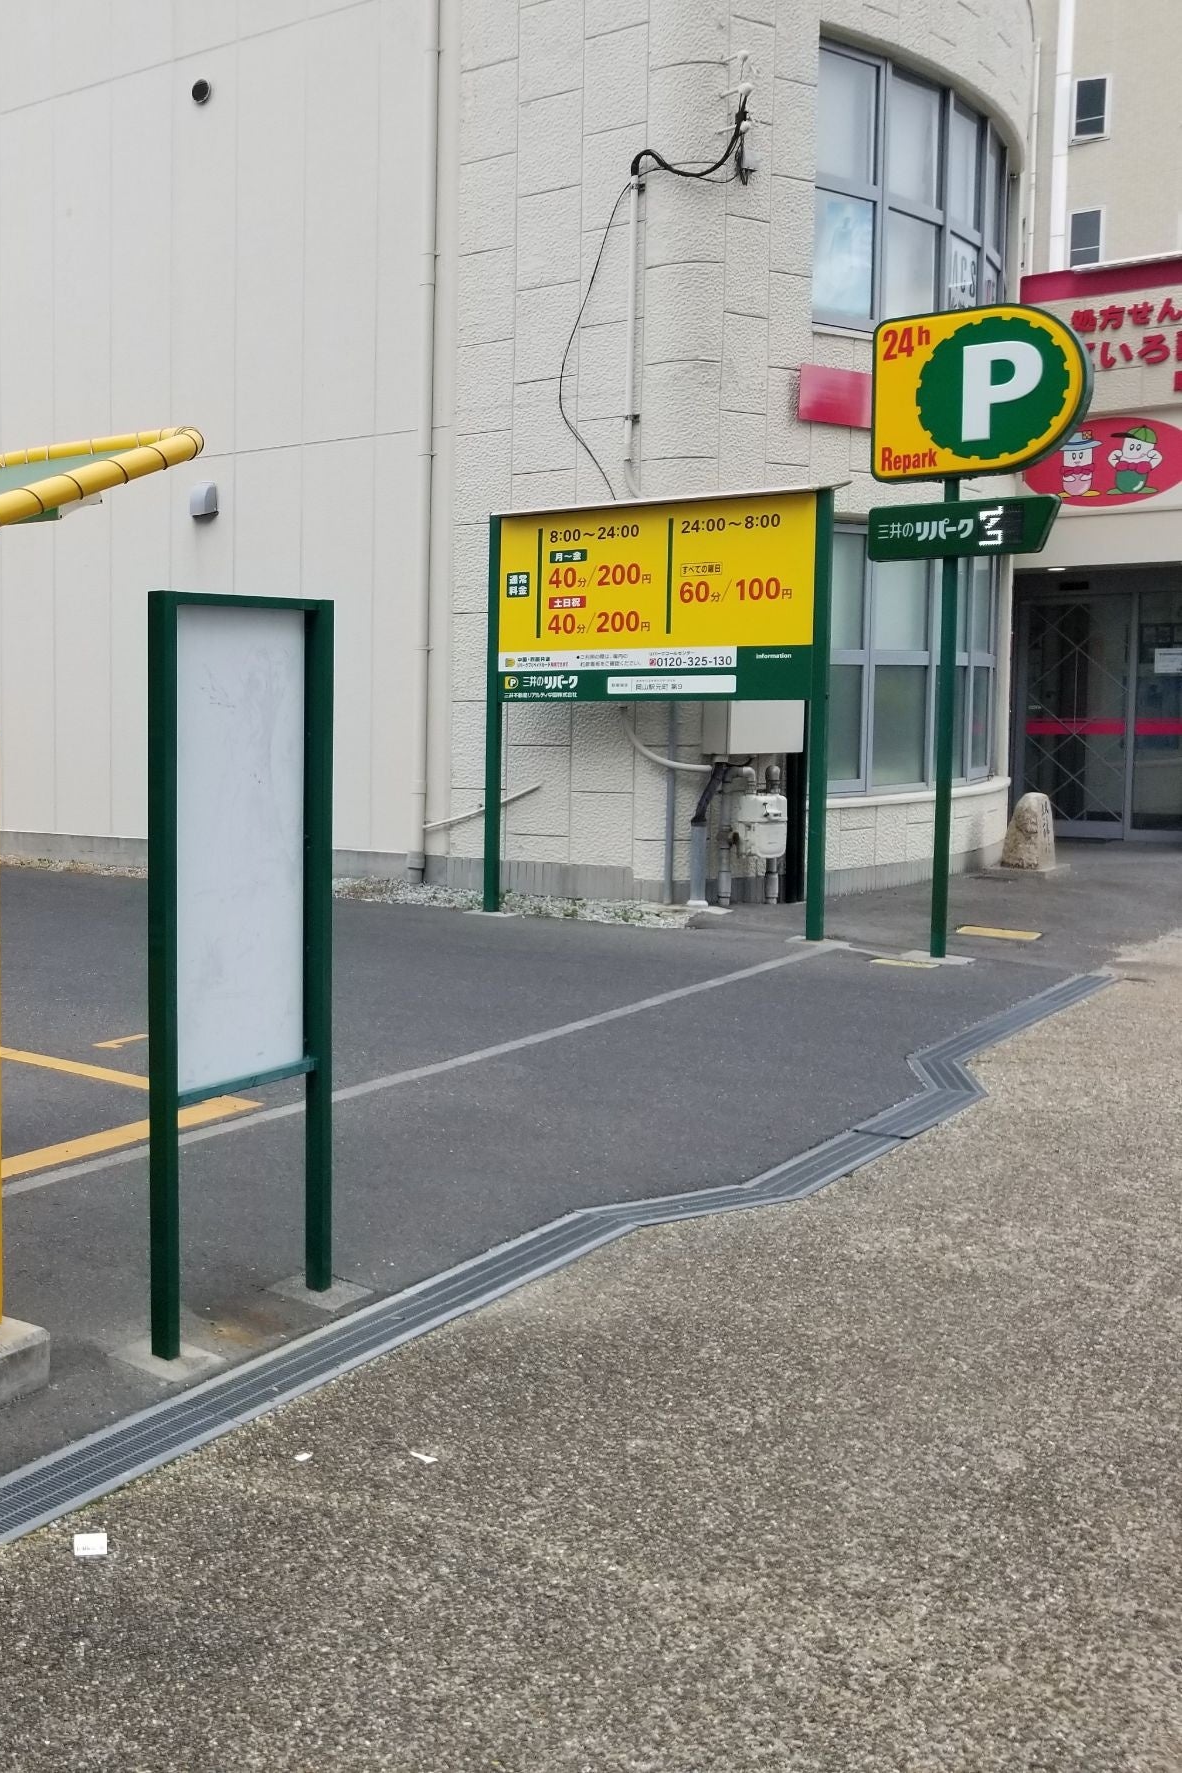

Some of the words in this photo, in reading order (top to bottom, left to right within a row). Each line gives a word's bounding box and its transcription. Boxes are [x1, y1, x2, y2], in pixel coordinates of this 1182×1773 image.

[961, 340, 1044, 443] P
[881, 447, 938, 473] Repark
[878, 517, 974, 541] 三井のリパーク
[656, 655, 733, 667] 0120-325-130
[523, 675, 579, 690] 三井のリパーク
